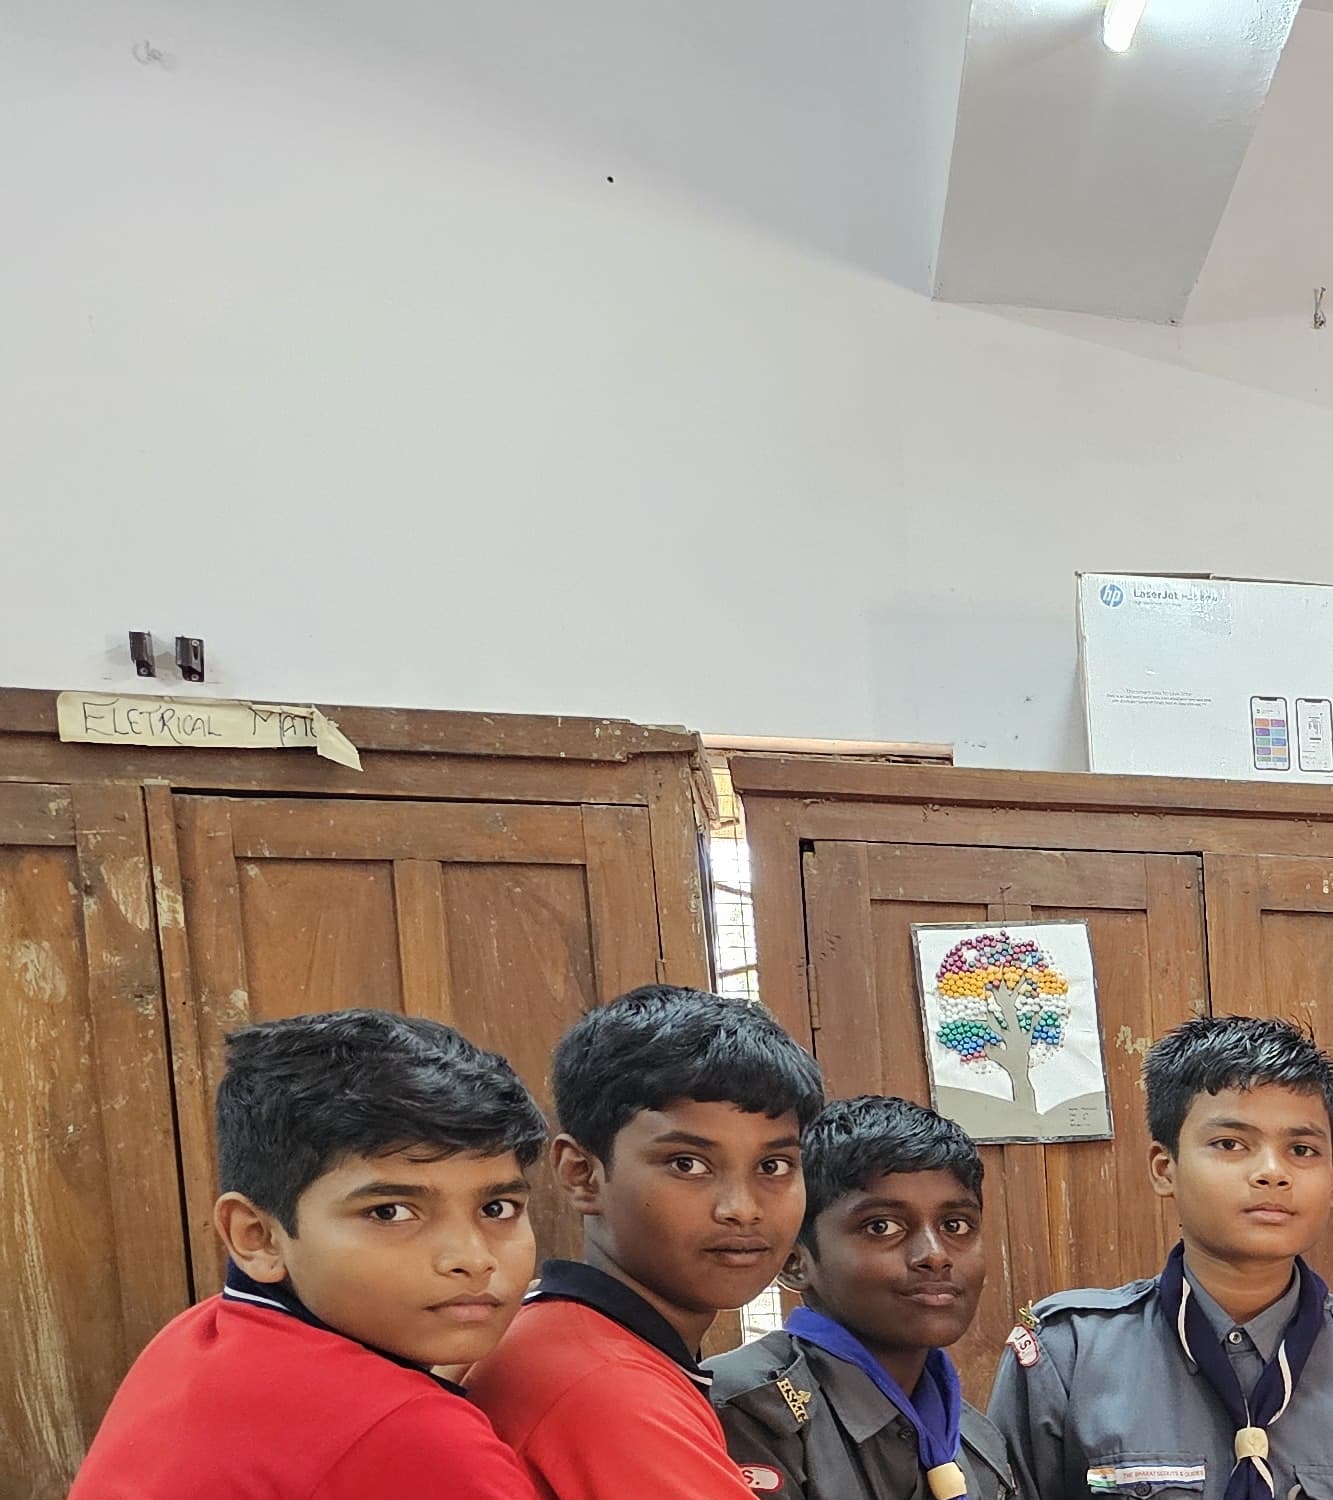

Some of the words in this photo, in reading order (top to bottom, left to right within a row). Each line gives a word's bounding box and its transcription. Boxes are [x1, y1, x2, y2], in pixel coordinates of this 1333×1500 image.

[1102, 584, 1124, 608] hp
[1133, 588, 1179, 600] LaserJet
[82, 698, 222, 745] ELETRICAL
